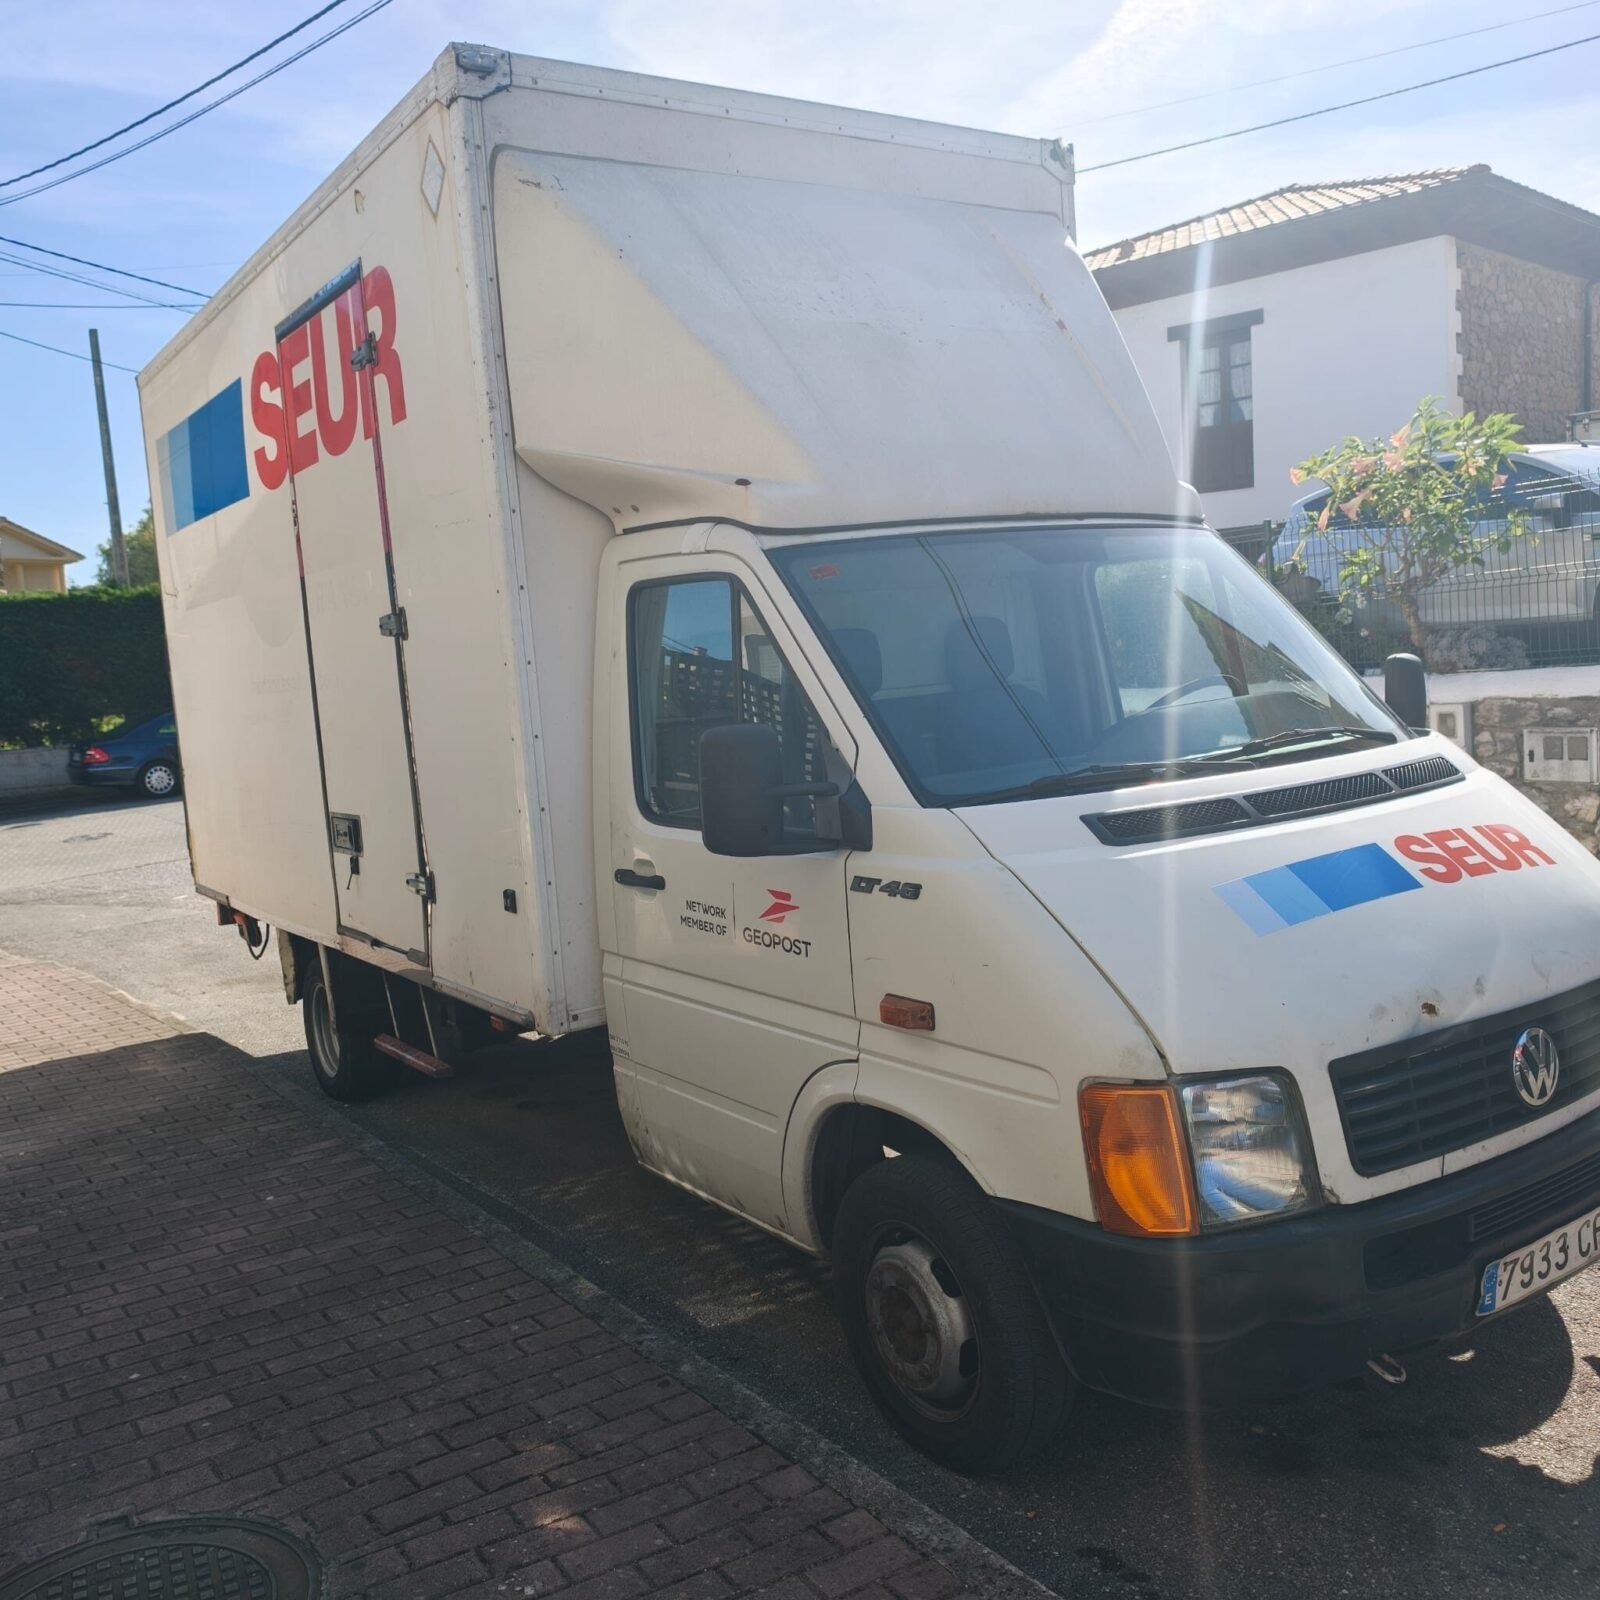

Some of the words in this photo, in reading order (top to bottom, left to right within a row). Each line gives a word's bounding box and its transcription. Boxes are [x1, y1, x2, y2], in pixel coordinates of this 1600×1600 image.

[251, 265, 407, 490] SEUR
[1394, 823, 1557, 884] SEUR
[850, 875, 882, 894] LT
[686, 899, 727, 919] NETWORK
[680, 914, 715, 934] MEMBER
[715, 924, 727, 936] OF
[743, 926, 811, 958] GEOPOST
[1502, 1231, 1569, 1301] 7933
[1484, 1293, 1492, 1305] E
